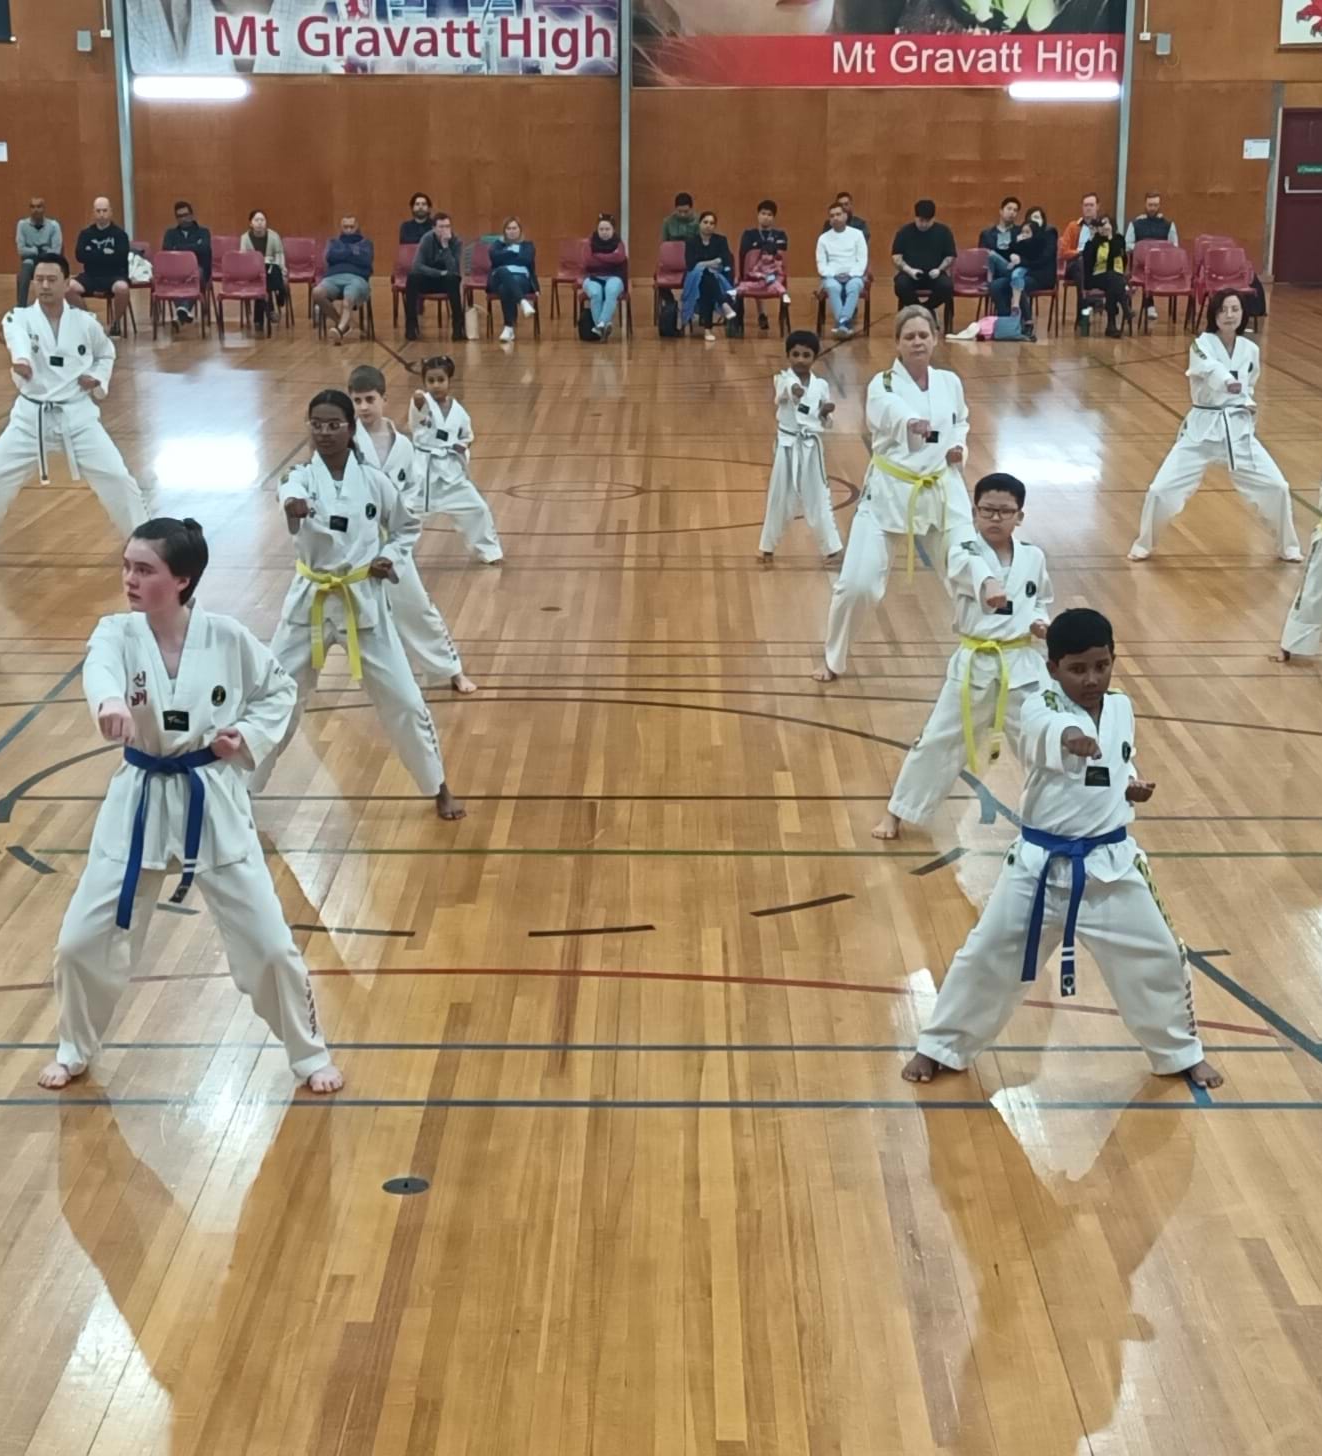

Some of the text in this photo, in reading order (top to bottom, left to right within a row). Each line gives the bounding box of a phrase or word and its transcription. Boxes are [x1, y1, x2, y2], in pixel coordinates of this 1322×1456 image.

[214, 15, 613, 70] Mt Gravatt High
[831, 40, 1118, 80] Mt Gravatt High
